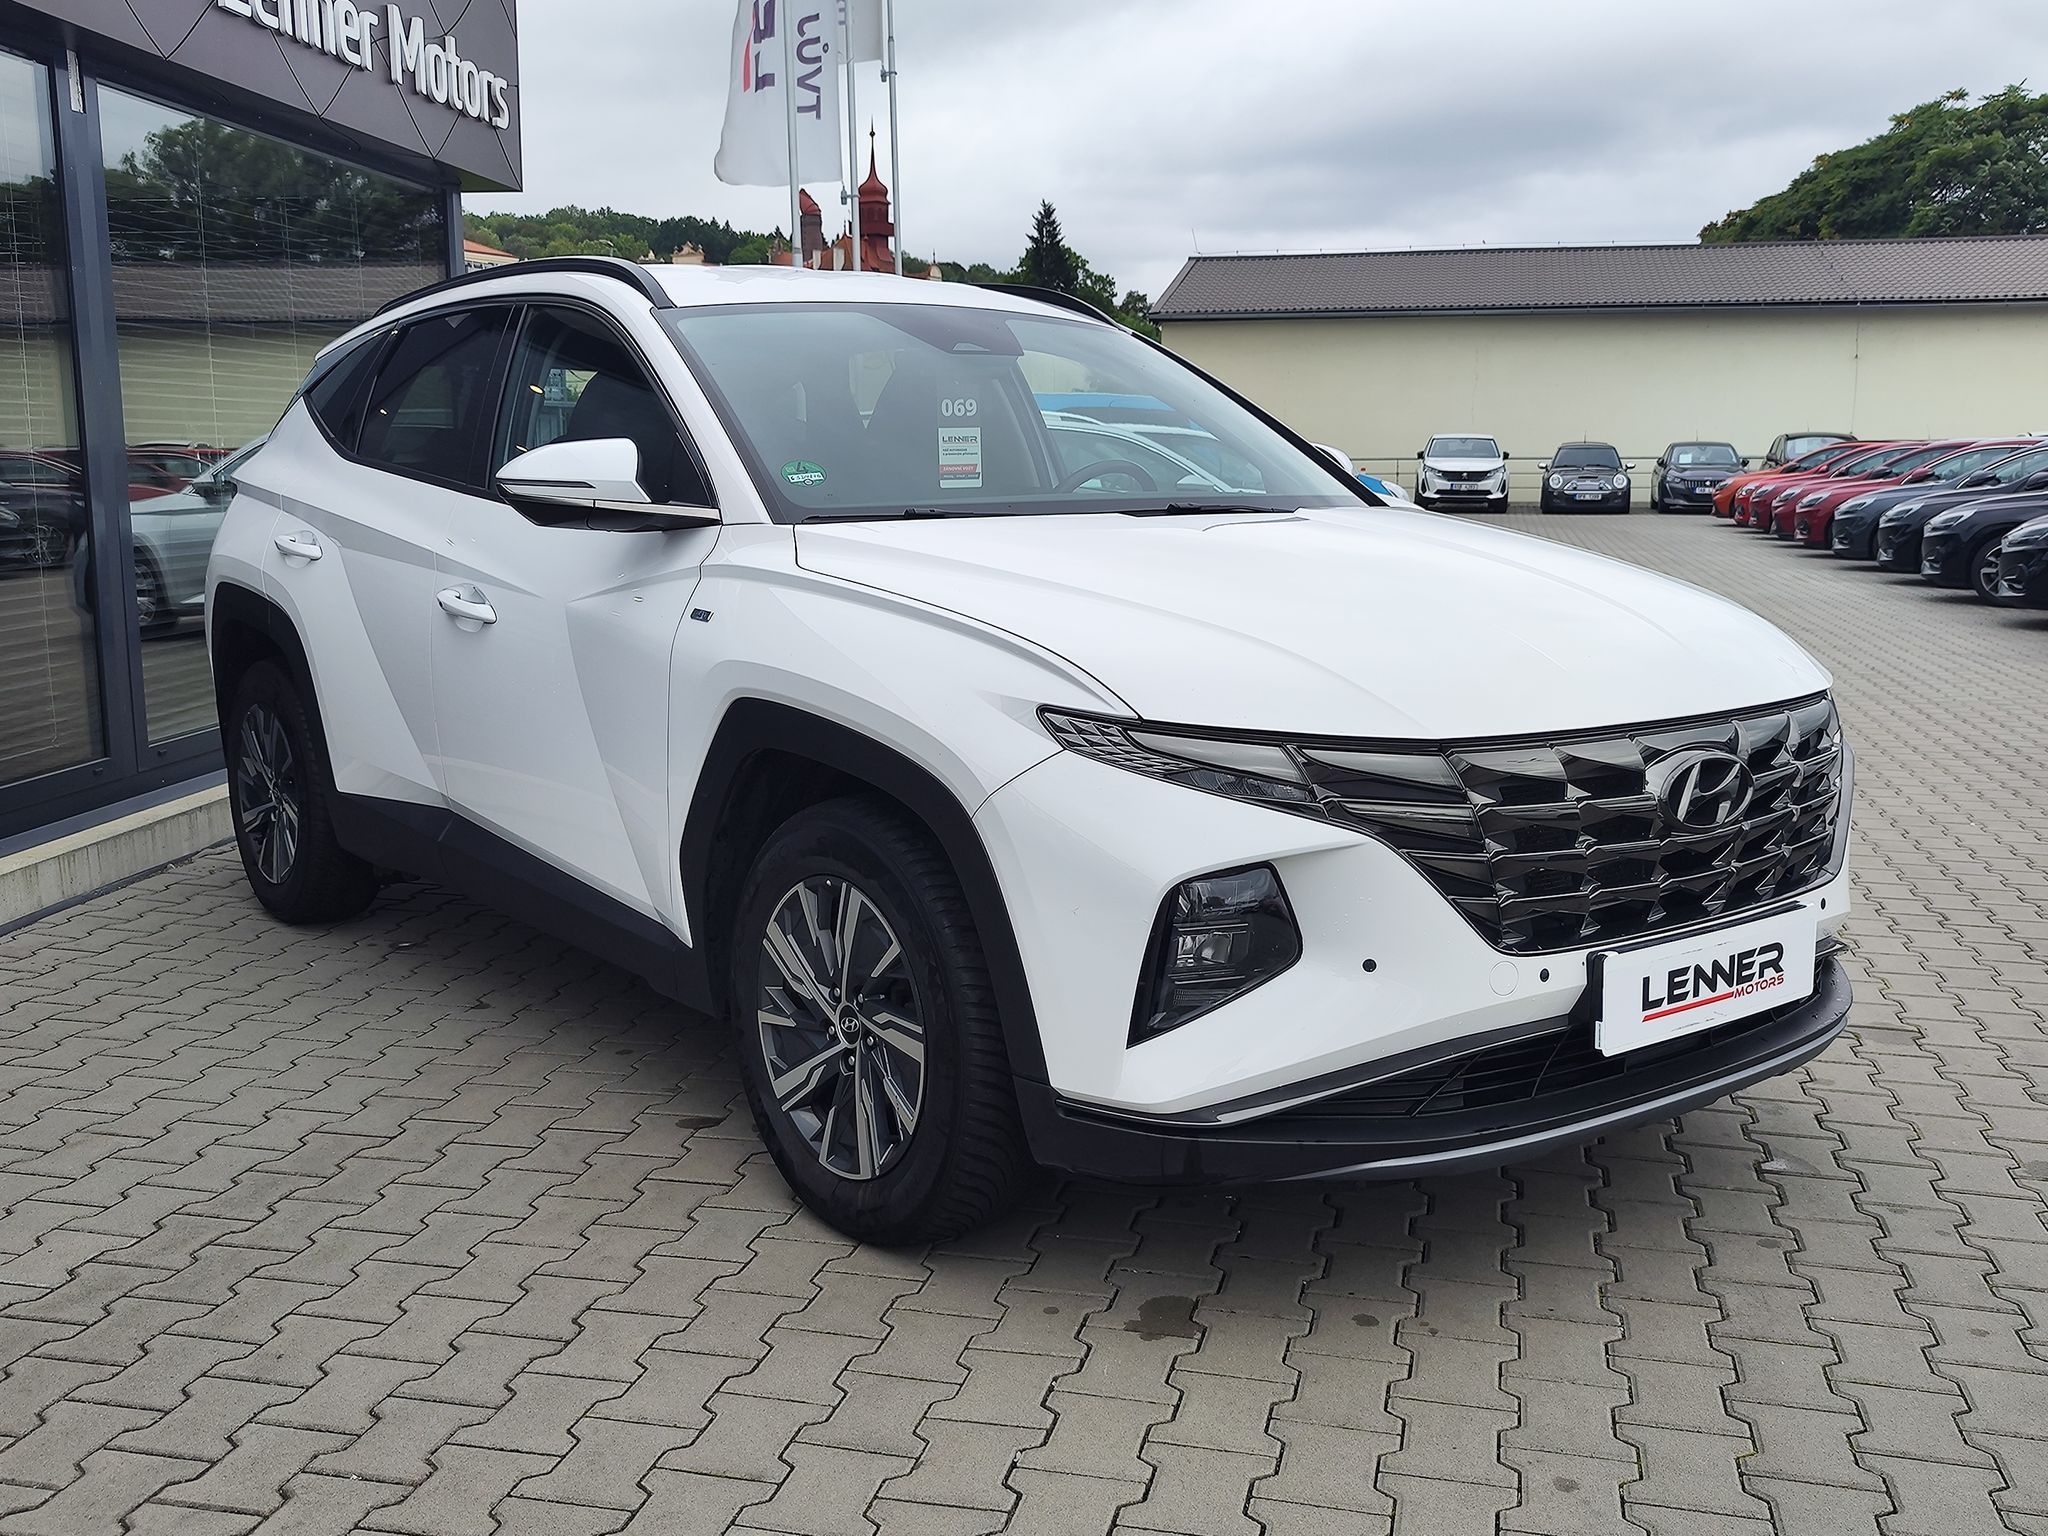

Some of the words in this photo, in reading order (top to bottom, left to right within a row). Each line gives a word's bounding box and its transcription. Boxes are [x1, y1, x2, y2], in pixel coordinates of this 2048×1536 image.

[386, 3, 510, 130] Motors
[941, 398, 978, 417] 069
[942, 435, 978, 443] LENNER
[1642, 942, 1784, 1012] LENNER
[1734, 974, 1784, 999] MOTORS
